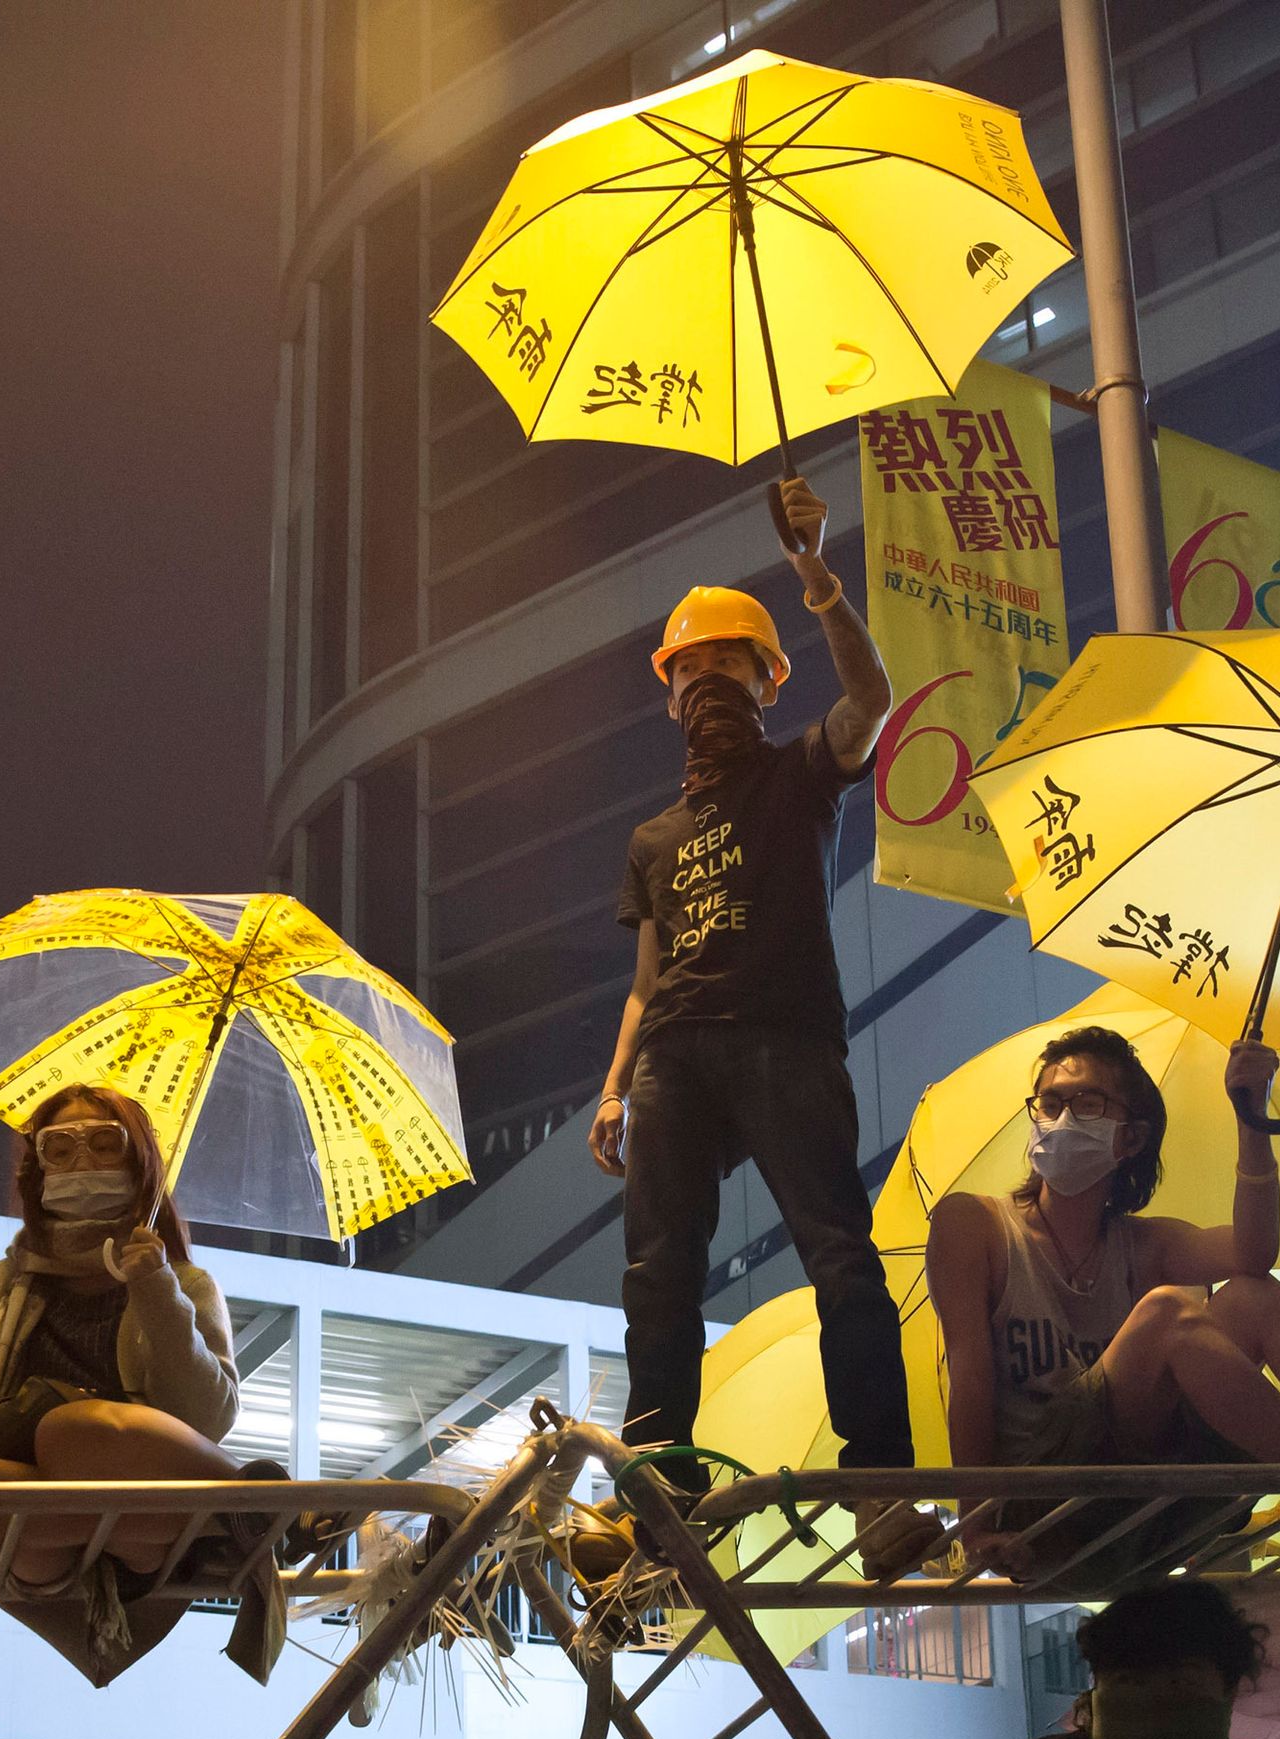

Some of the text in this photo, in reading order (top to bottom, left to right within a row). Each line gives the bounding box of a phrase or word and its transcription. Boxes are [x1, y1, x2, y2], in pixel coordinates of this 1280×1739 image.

[861, 408, 1033, 494] 熱烈
[942, 489, 1060, 553] 慶祝
[883, 542, 1040, 612] 中華人民共和國
[884, 569, 1059, 647] 成立六十五周年
[672, 845, 742, 892] CALM
[678, 822, 732, 865] KEEP
[672, 906, 747, 958] FORCE
[685, 890, 728, 923] THE
